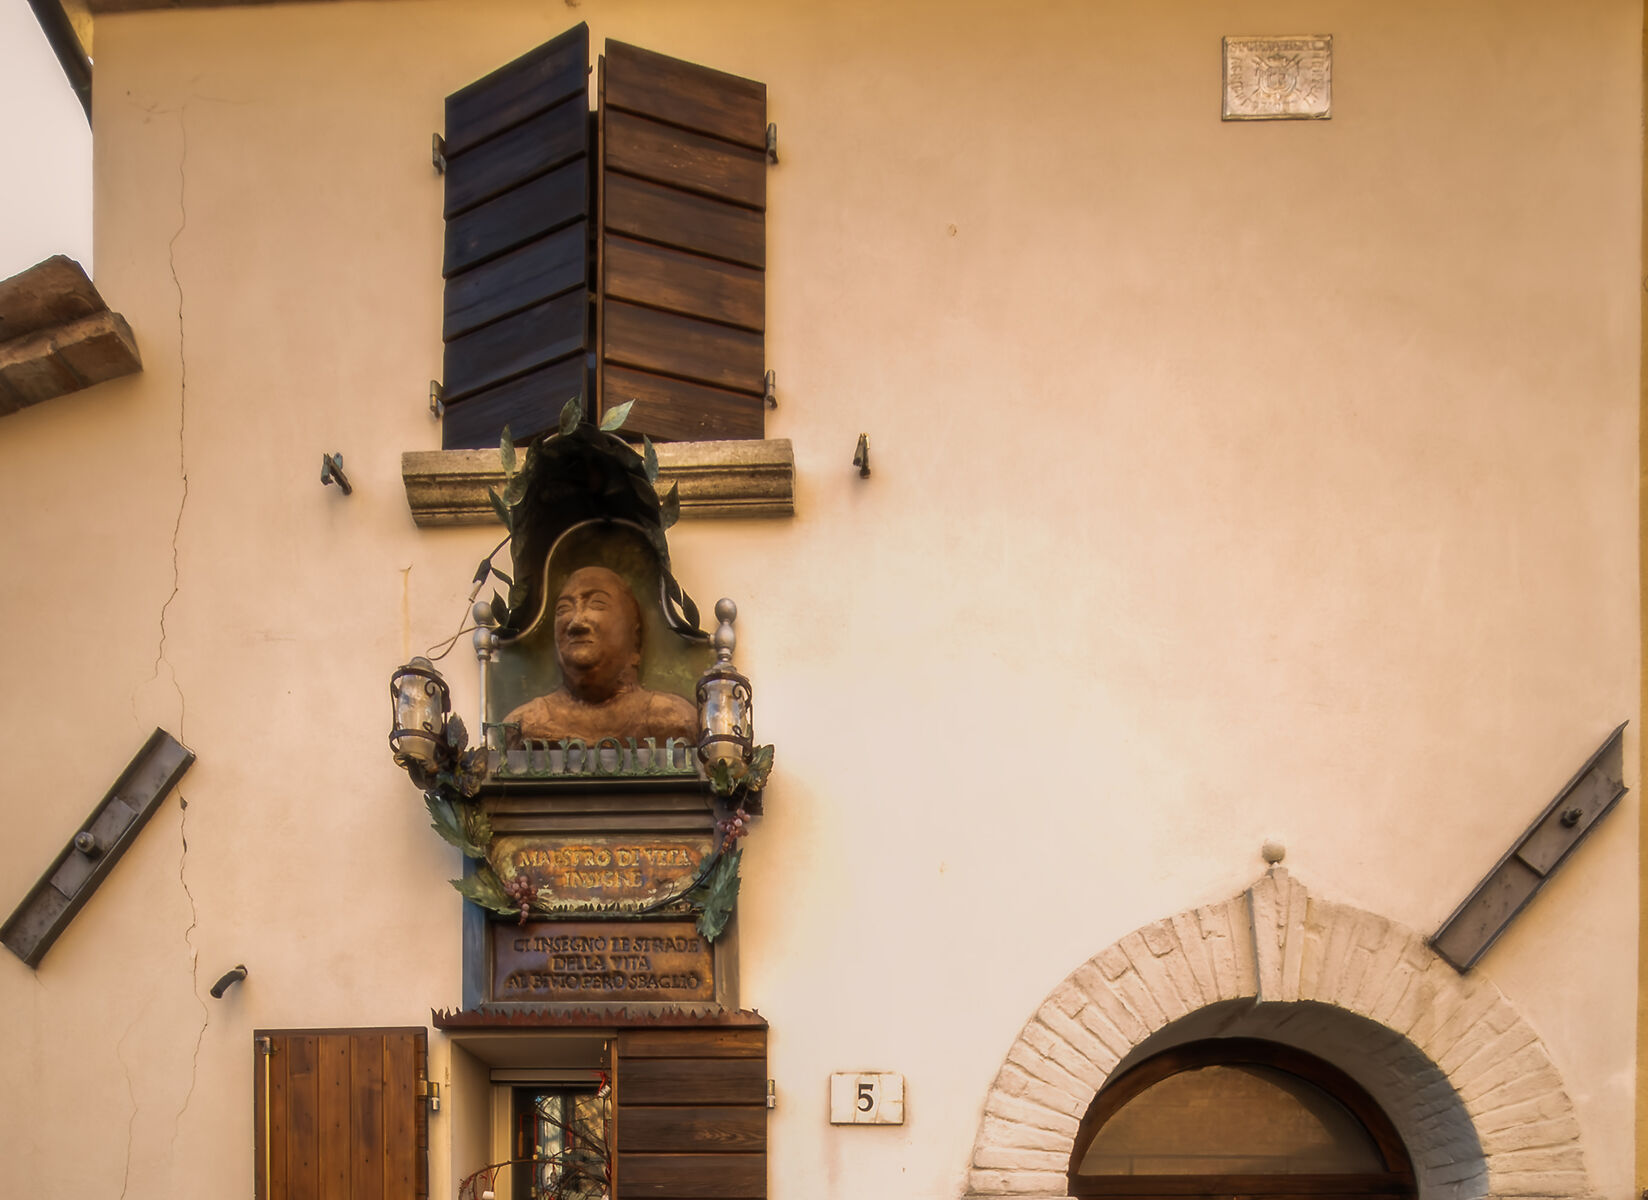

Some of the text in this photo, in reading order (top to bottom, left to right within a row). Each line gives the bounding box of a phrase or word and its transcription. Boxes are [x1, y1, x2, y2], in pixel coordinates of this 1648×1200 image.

[519, 848, 692, 868] MAESTRO DI VITA
[610, 937, 630, 952] LE
[632, 937, 700, 953] STRADE
[553, 955, 651, 971] DELLA VITA
[533, 972, 581, 989] BIVIO
[857, 1083, 874, 1112] 5
